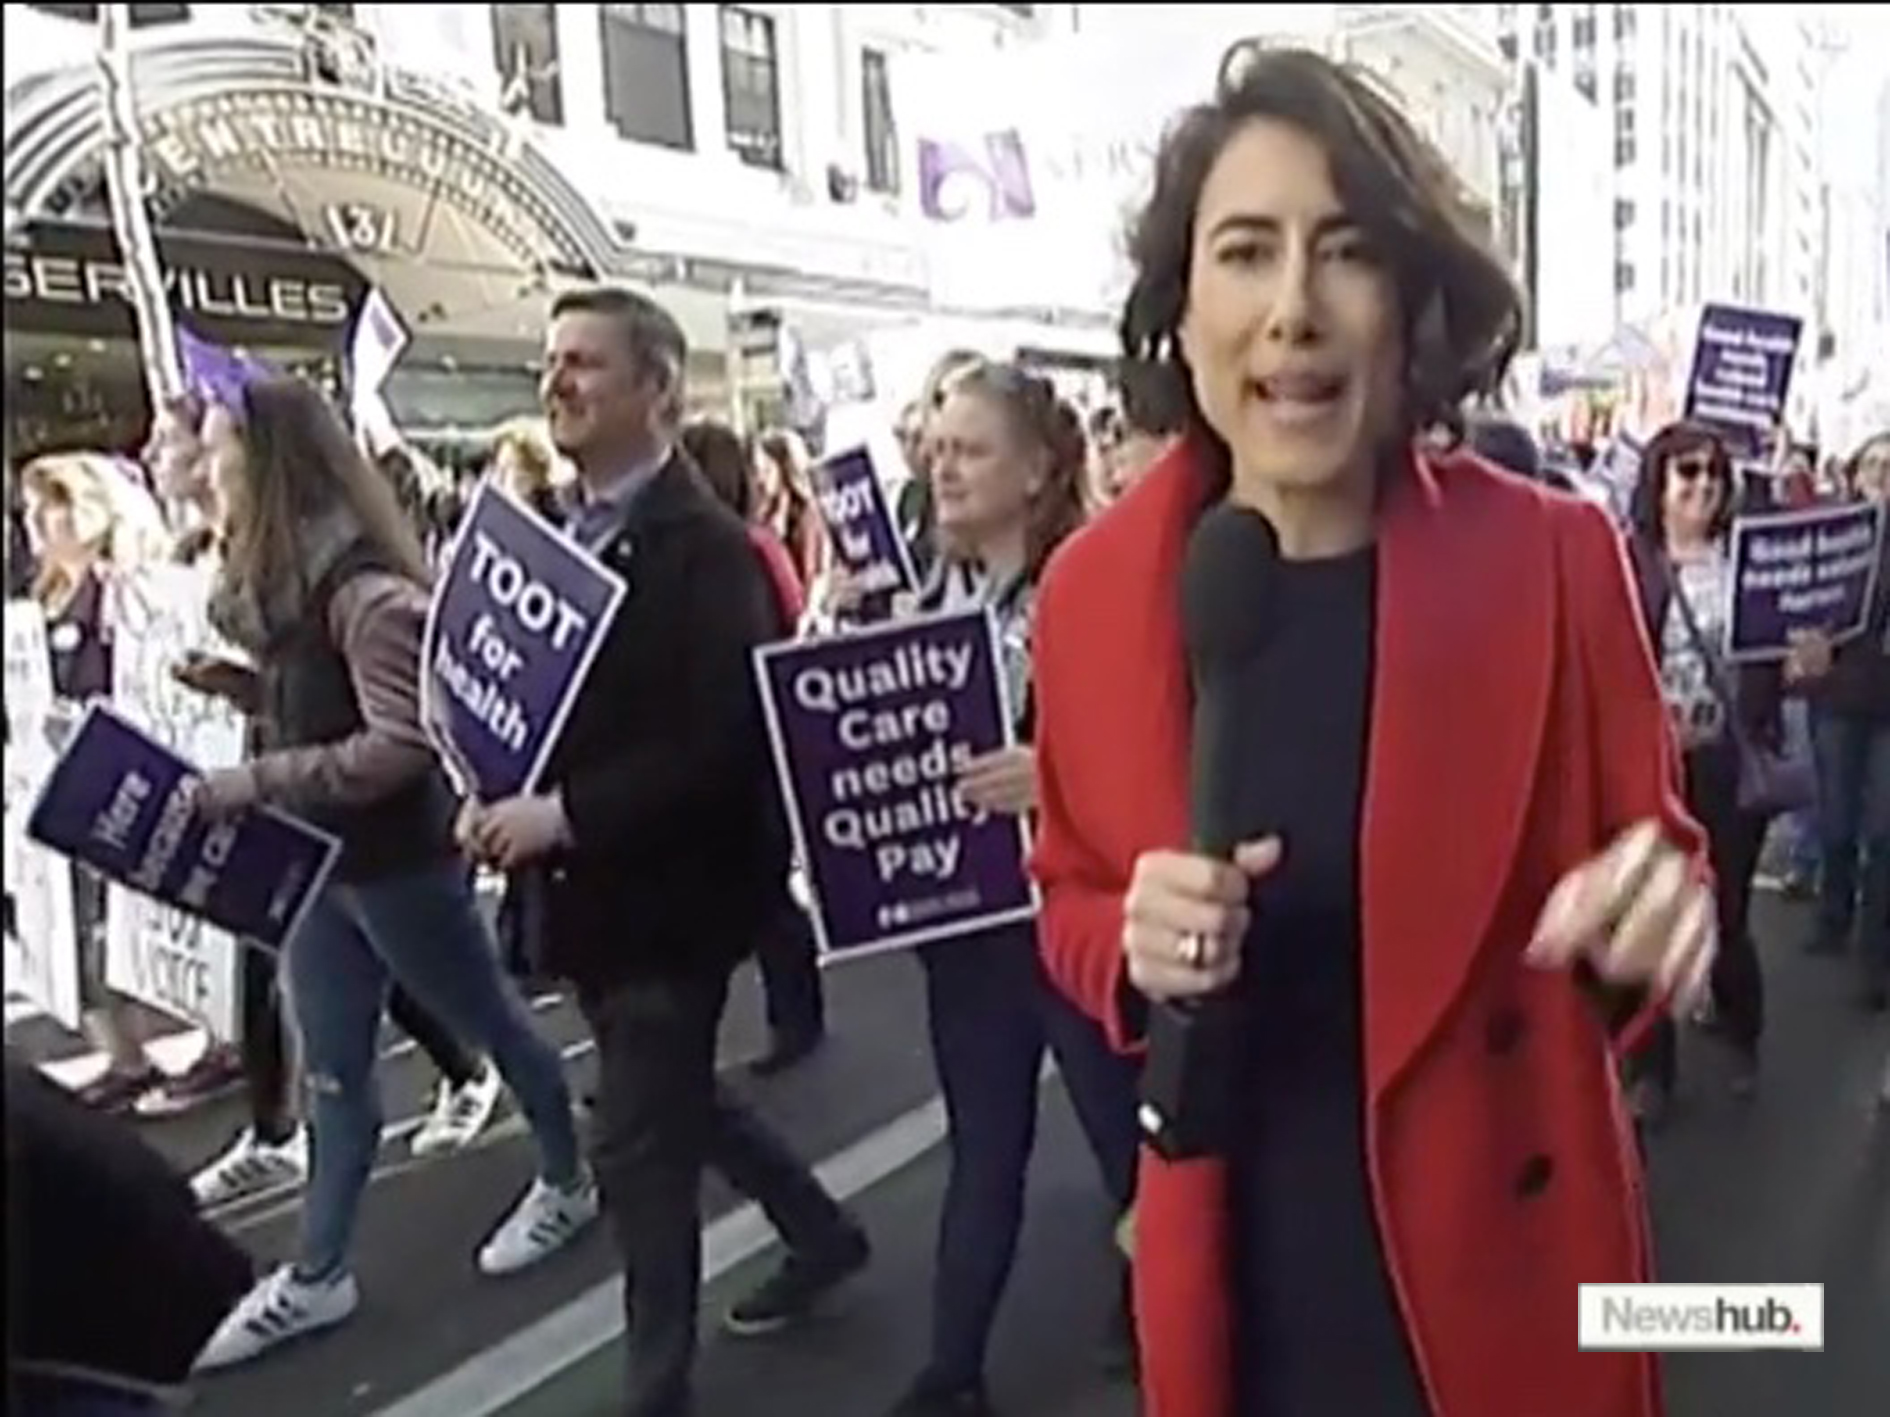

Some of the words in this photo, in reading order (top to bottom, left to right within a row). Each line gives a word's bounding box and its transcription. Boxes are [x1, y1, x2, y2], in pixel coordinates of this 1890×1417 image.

[325, 203, 396, 249] 131
[470, 530, 586, 650] TOOT
[470, 614, 524, 681] for
[795, 644, 971, 712] Quality
[434, 632, 528, 750] health
[838, 700, 949, 749] Care
[831, 738, 972, 801] needs
[93, 771, 151, 852] Here
[876, 836, 960, 882] Pay
